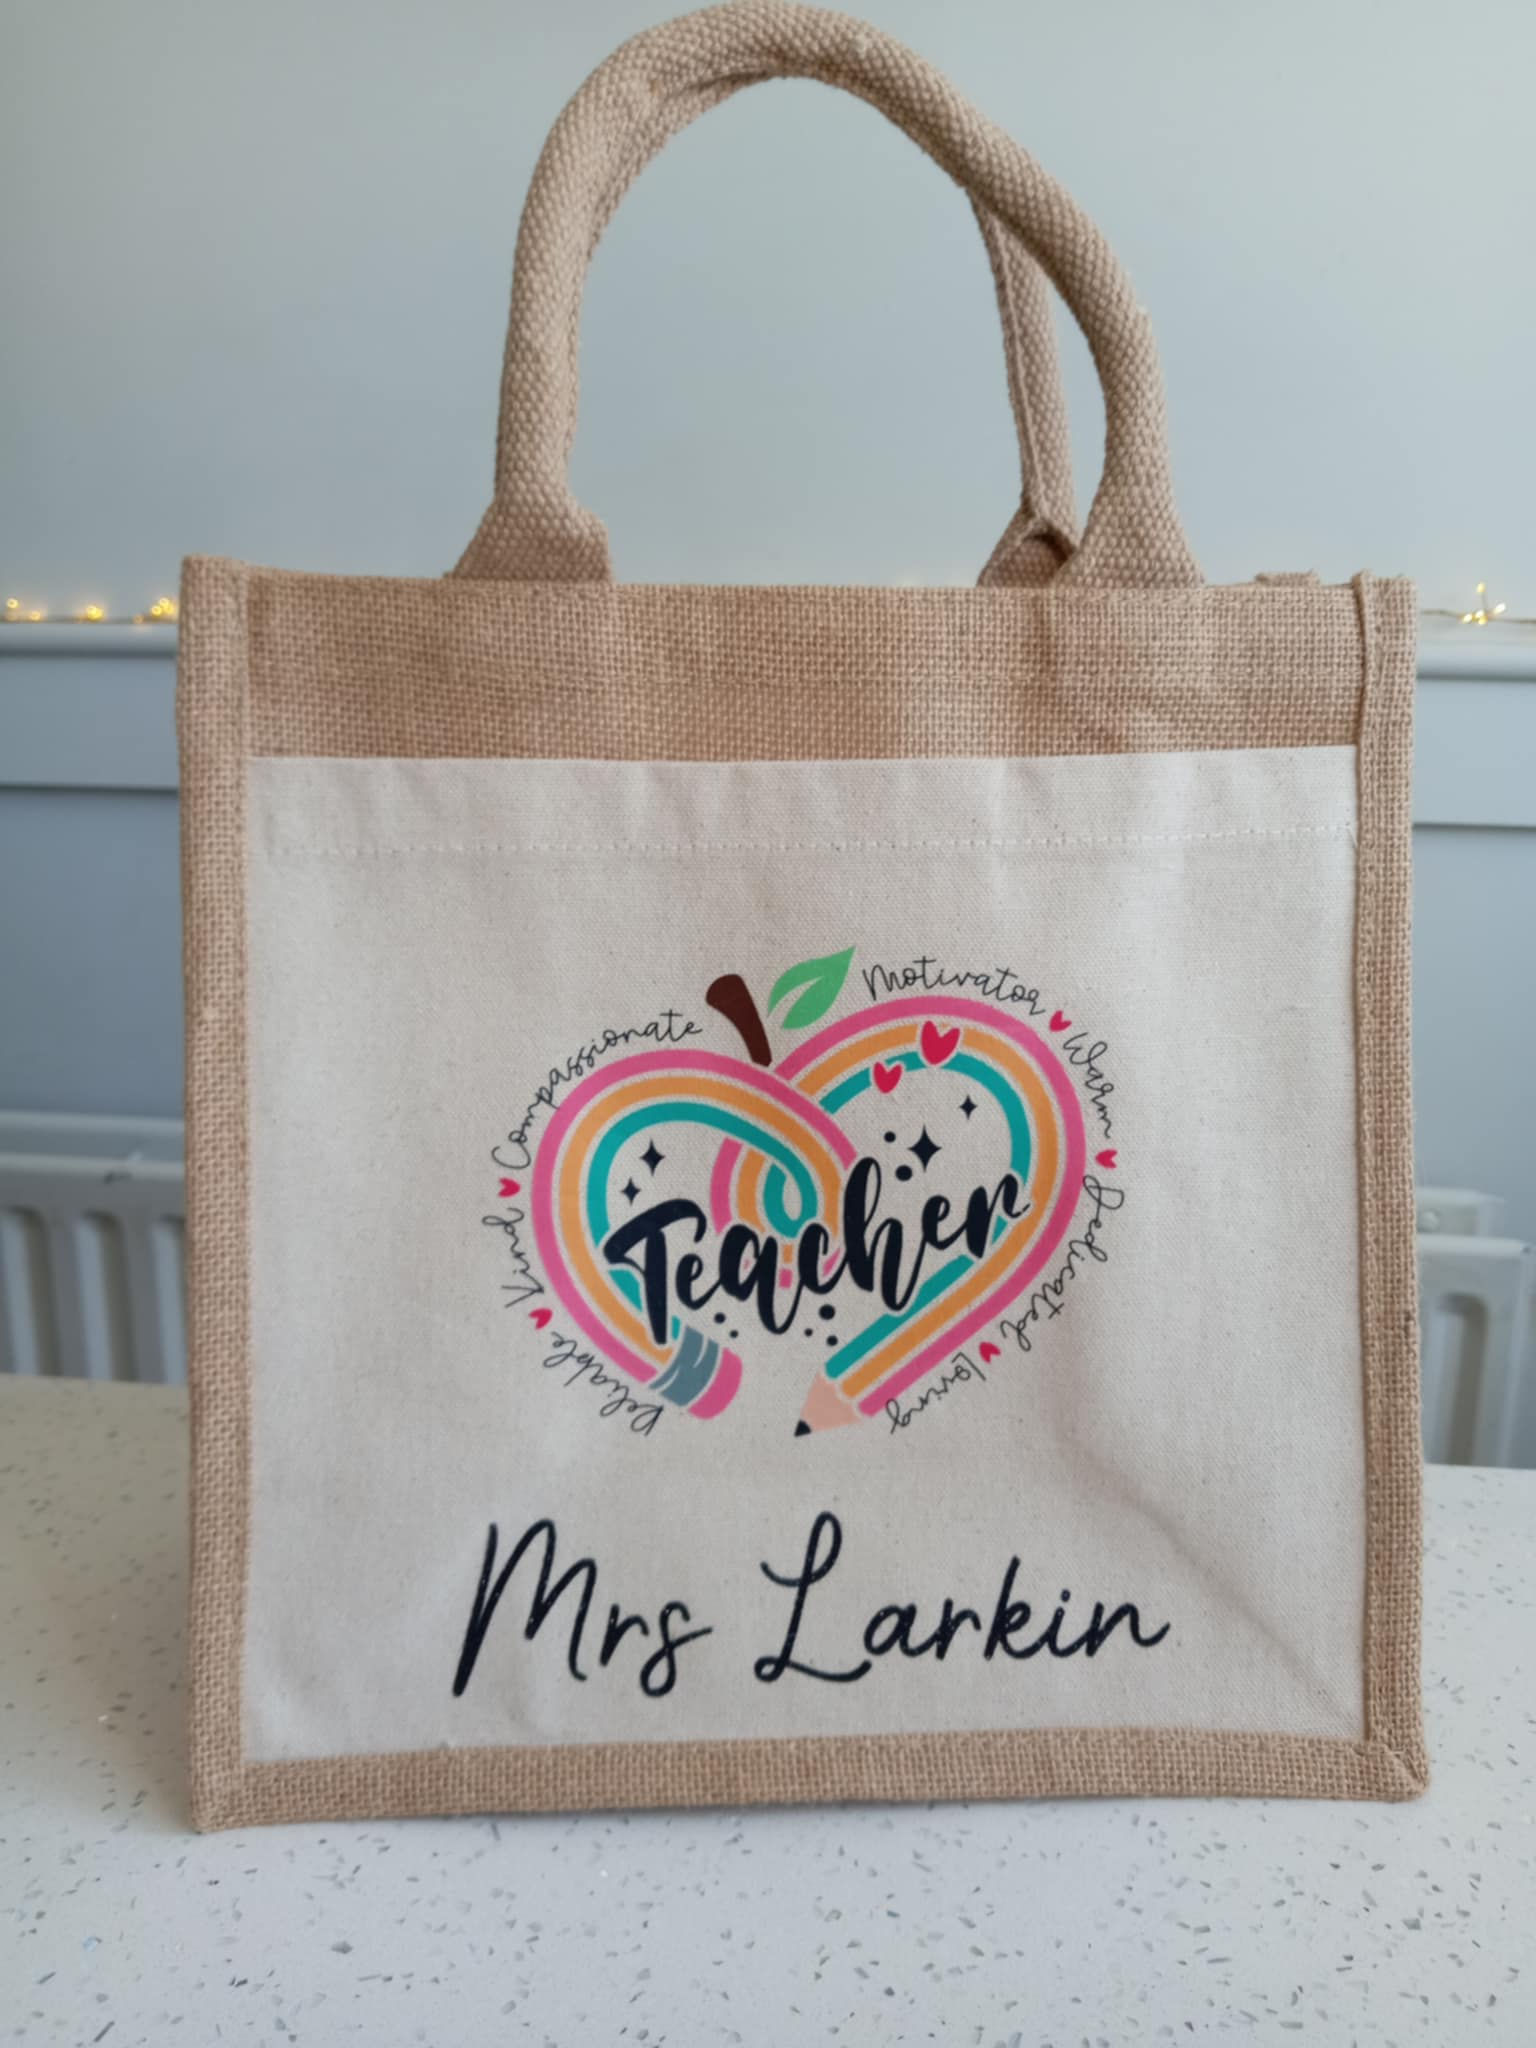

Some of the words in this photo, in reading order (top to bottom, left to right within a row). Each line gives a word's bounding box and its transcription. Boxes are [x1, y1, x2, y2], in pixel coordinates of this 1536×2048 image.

[862, 955, 1046, 1016] Motivator
[491, 1008, 703, 1170] Compassionate
[1062, 1031, 1115, 1139] Warm
[482, 1207, 545, 1308] Kind
[602, 1157, 1030, 1346] Teacher
[1000, 1174, 1125, 1352] Dedicated
[543, 1331, 664, 1436] Reliable
[884, 1350, 987, 1435] Loving
[452, 1518, 713, 1698] Mrs
[754, 1511, 1170, 1683] Larkin
